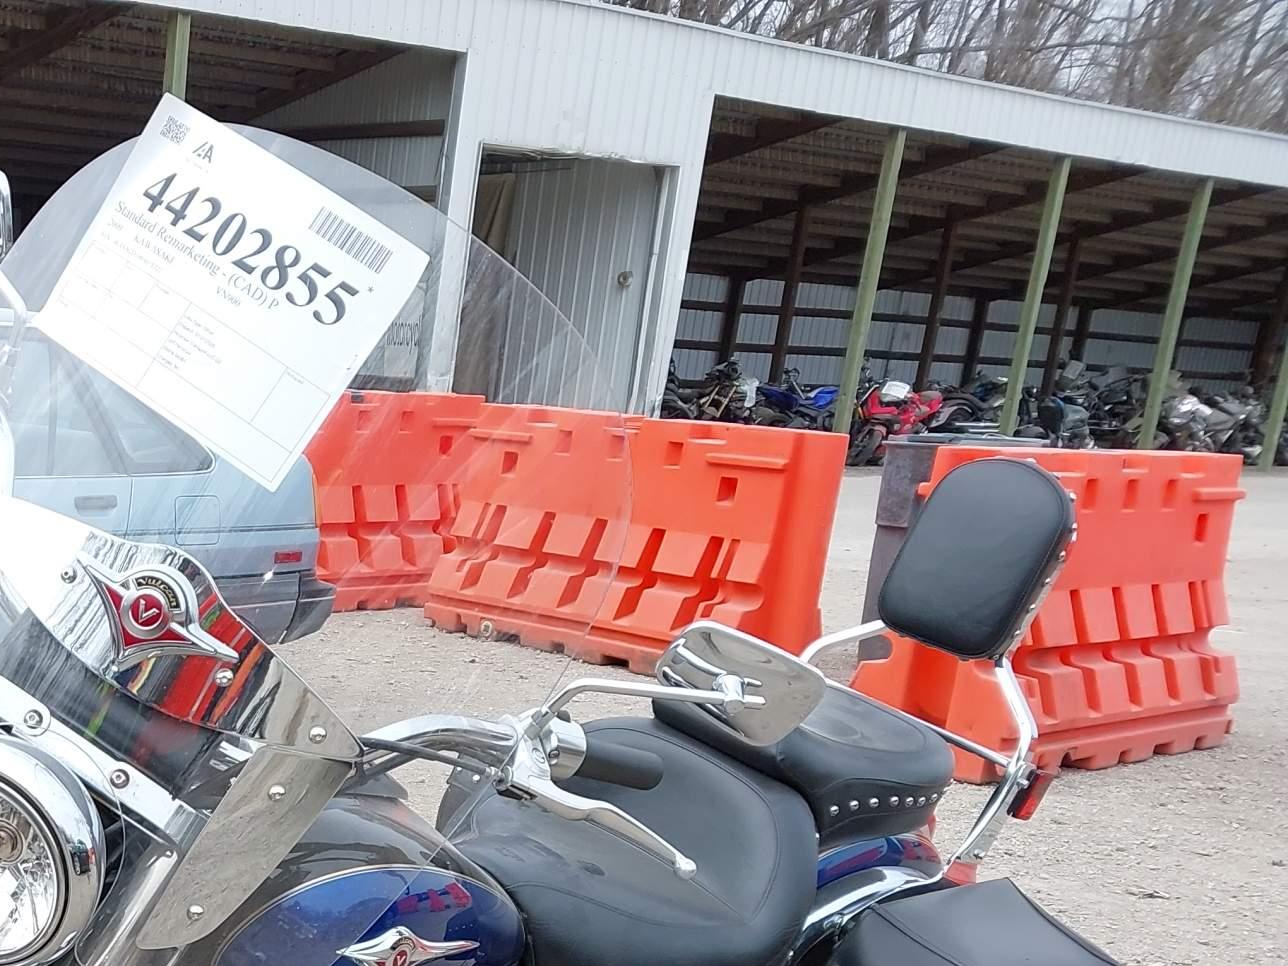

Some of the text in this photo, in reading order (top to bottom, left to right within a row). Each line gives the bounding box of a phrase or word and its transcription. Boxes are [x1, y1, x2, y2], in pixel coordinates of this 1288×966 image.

[114, 200, 156, 233] Standard
[156, 226, 221, 277] Remarketing
[227, 272, 269, 306] (CAD)
[267, 297, 279, 310] P
[142, 172, 359, 326] 44202855
[137, 577, 177, 608] Vulcan
